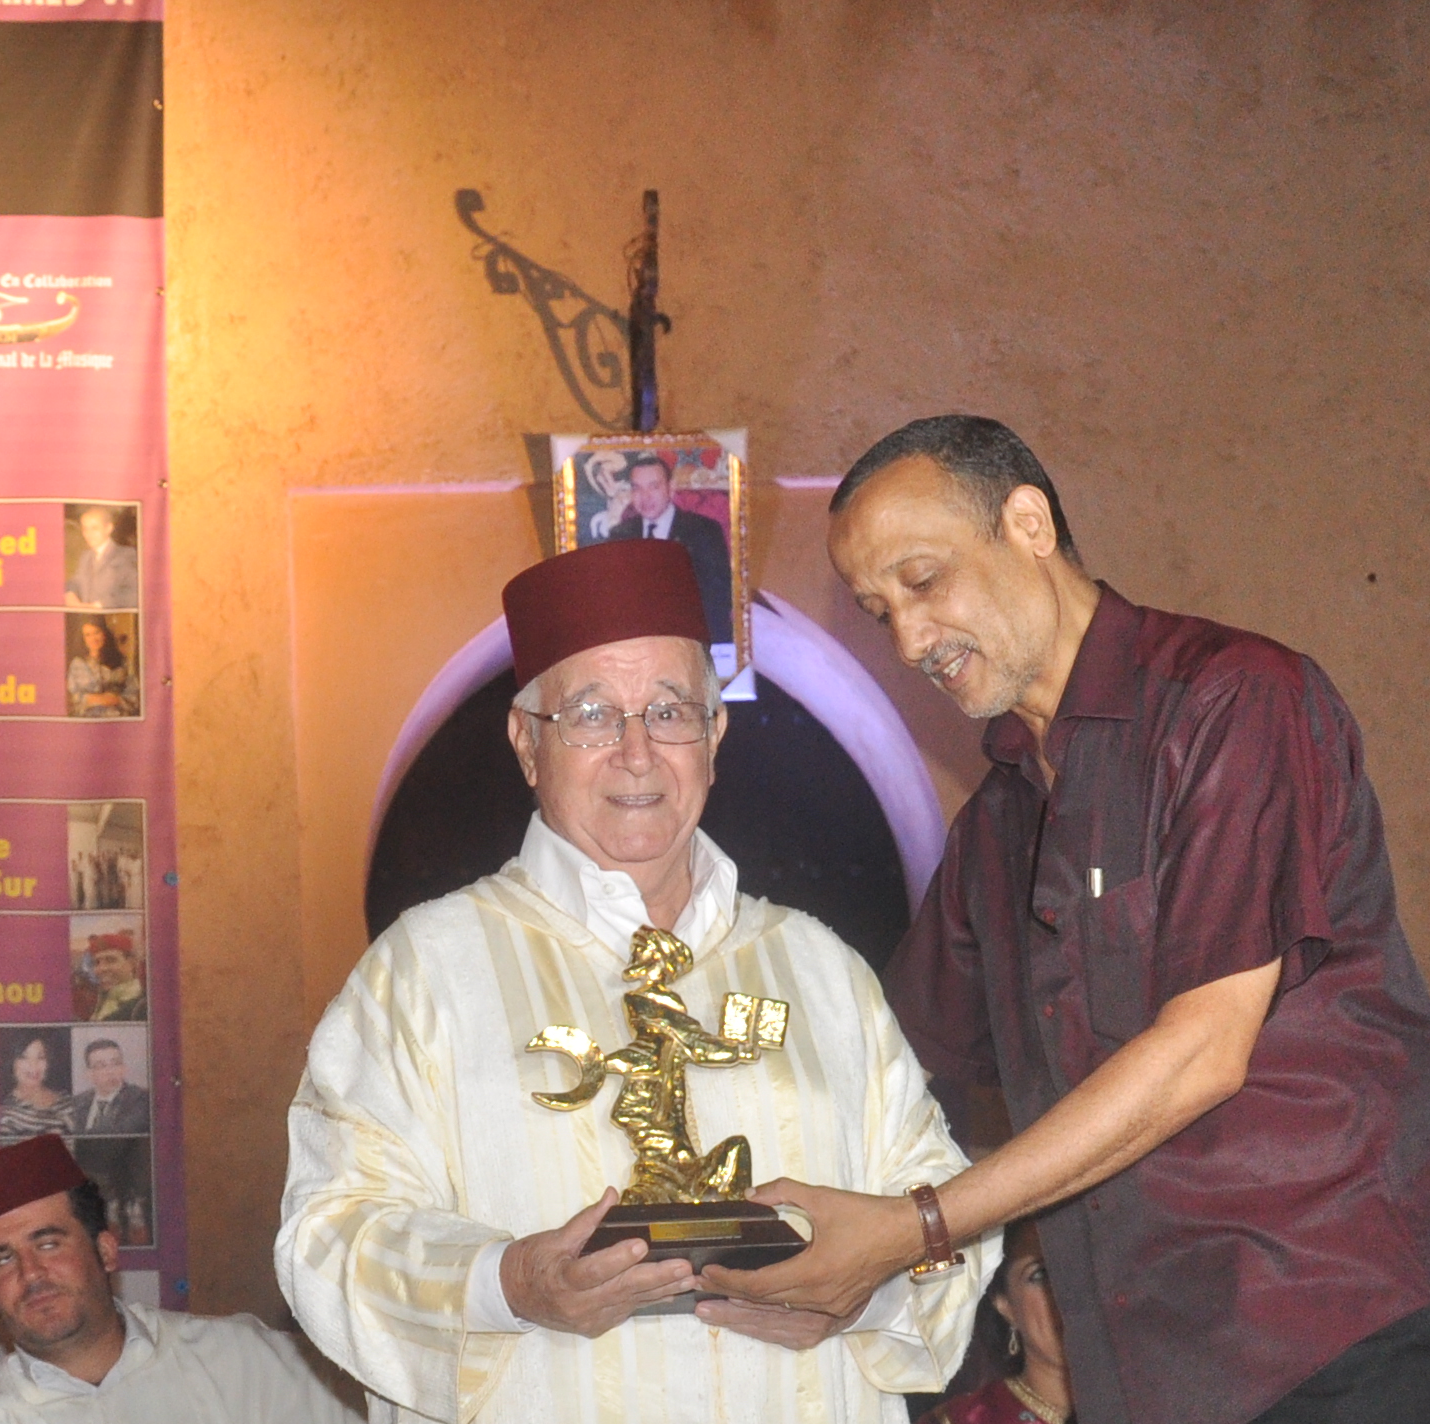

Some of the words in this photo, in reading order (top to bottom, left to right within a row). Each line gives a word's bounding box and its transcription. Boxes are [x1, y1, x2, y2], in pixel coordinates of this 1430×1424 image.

[21, 350, 36, 368] de
[40, 350, 53, 368] la
[56, 349, 114, 370] Musique
